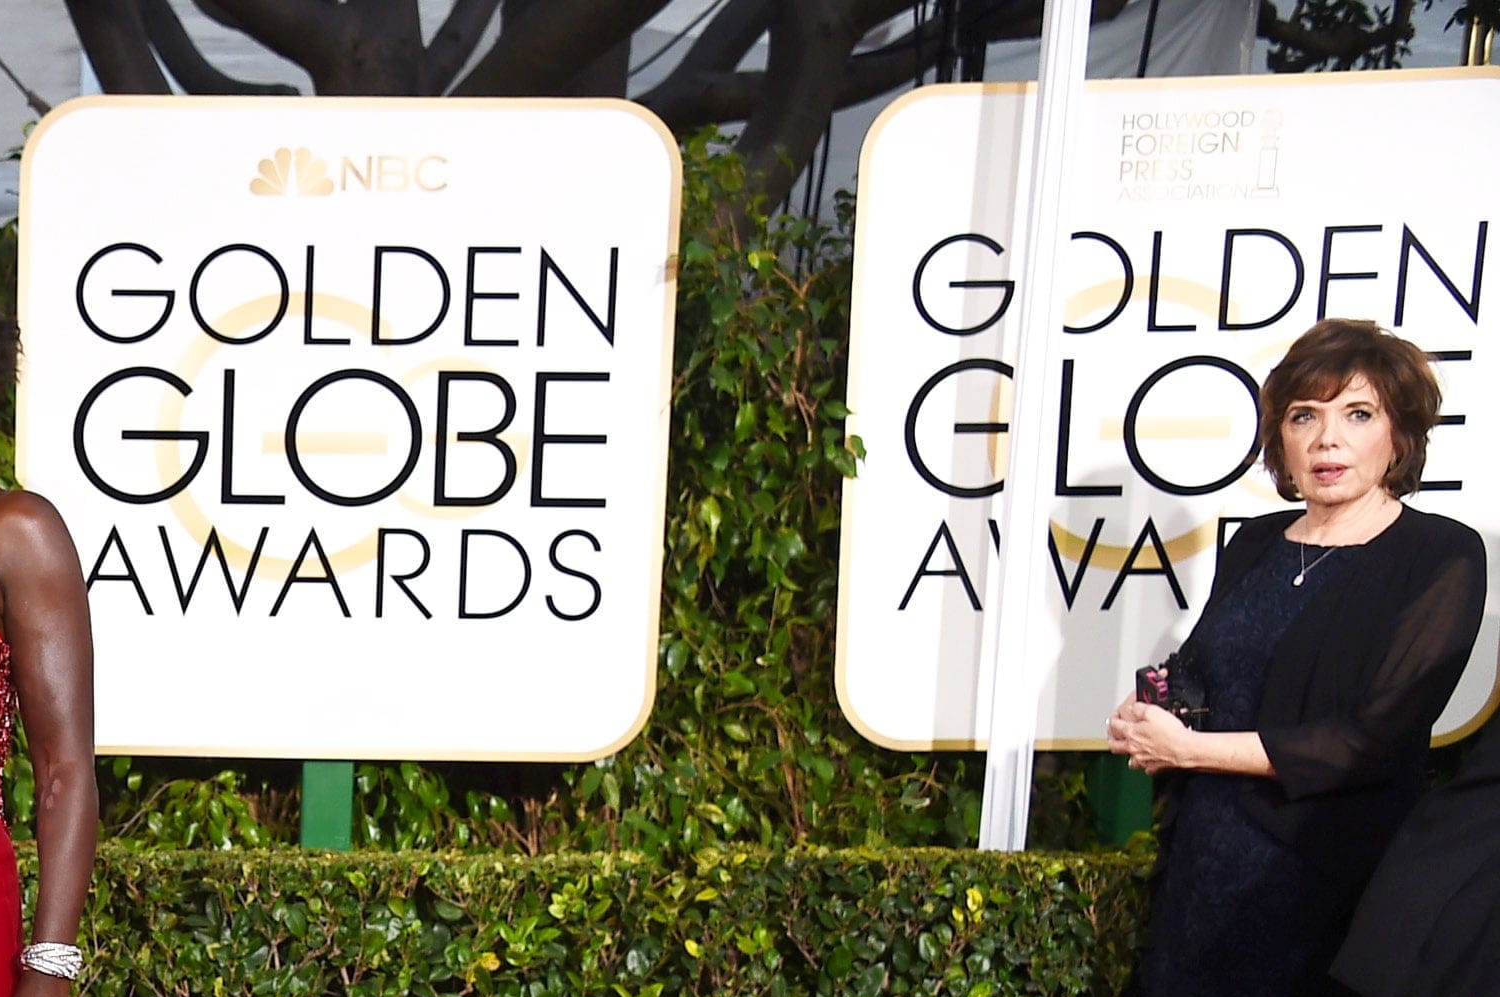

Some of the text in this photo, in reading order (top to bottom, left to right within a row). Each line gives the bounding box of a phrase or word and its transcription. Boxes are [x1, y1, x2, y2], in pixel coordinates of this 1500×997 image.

[1120, 131, 1241, 157] FOREIGN
[1121, 109, 1256, 131] HOLLYWOOD
[340, 153, 450, 193] NBC
[1118, 159, 1194, 182] PRESS
[75, 243, 619, 348] GOLDEN
[912, 220, 1489, 337] GOLDEN
[72, 366, 611, 508] GLOBE
[904, 350, 1473, 499] GLO
[86, 525, 603, 622] AWARDS
